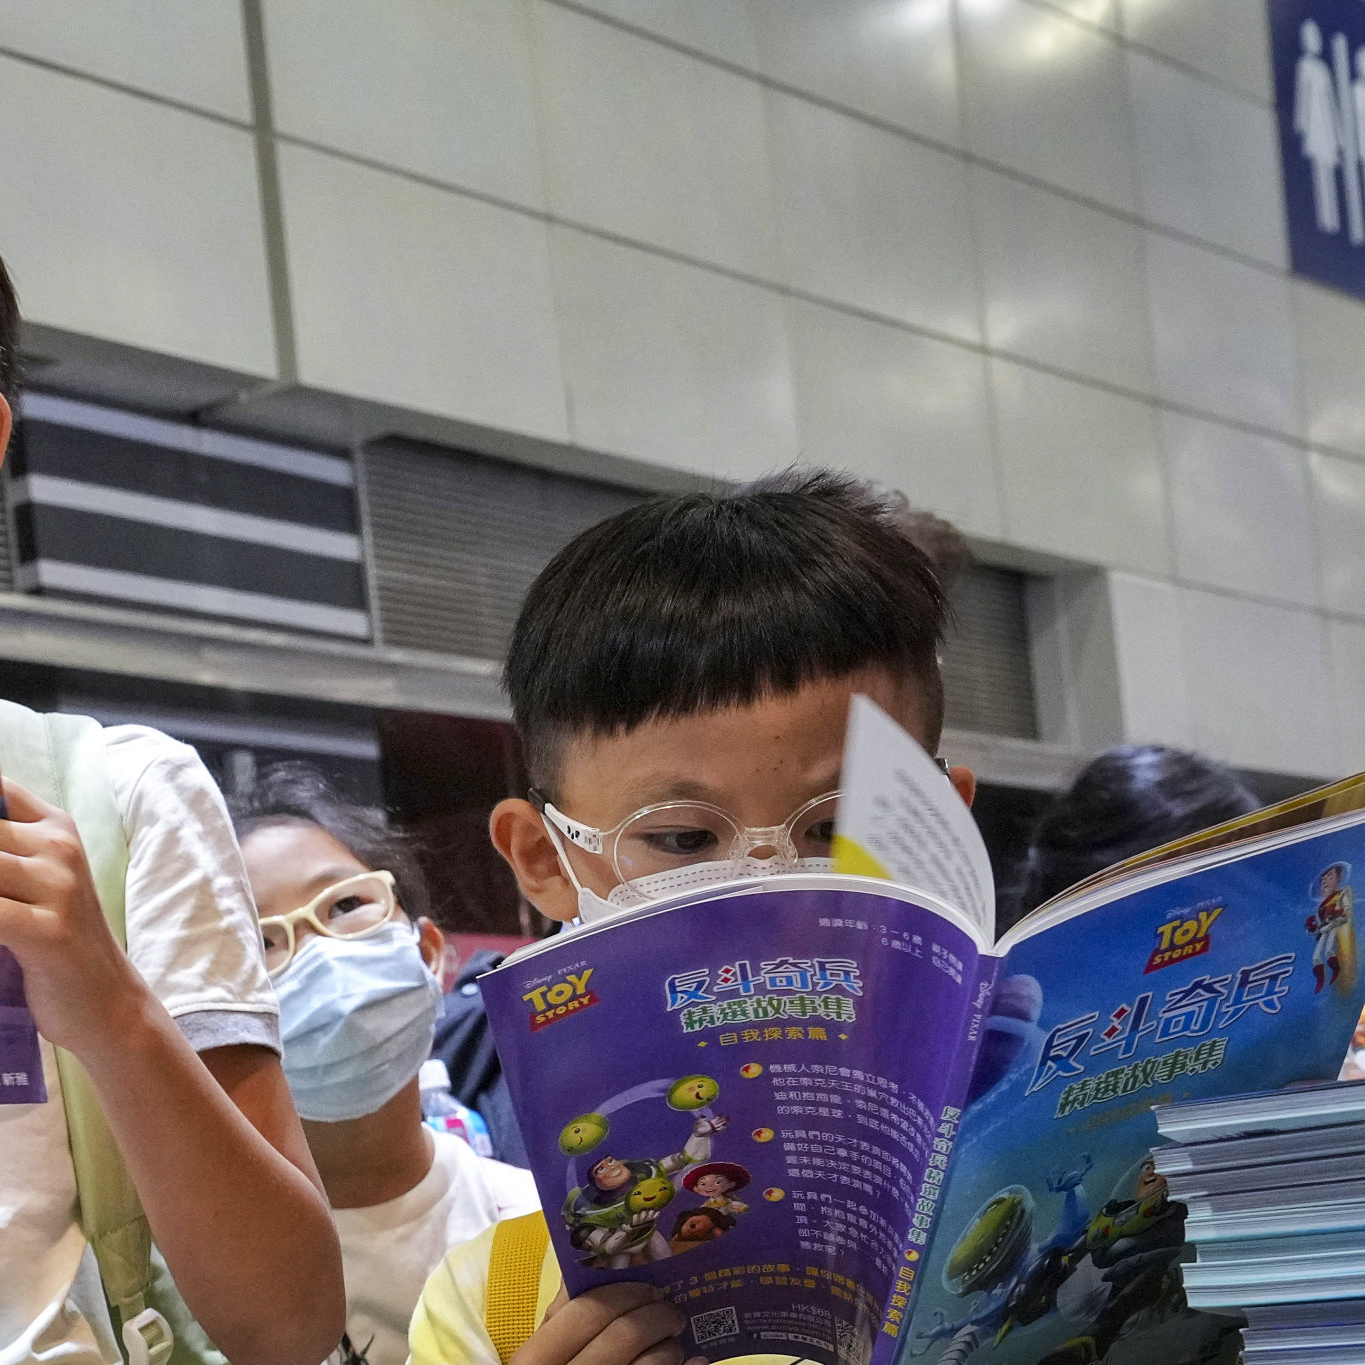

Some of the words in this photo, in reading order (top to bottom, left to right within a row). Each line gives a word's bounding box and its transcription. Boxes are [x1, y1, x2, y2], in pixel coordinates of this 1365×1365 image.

[1156, 907, 1224, 951] TOY
[557, 961, 588, 975] PIXAR
[1152, 940, 1209, 966] STORY
[522, 968, 594, 1013] TOY
[666, 957, 864, 1012] 反斗奇兵
[535, 995, 591, 1024] STORY
[680, 995, 857, 1033] 精選故事集
[966, 1014, 983, 1041] PIXAR
[1025, 953, 1296, 1097] 反斗奇兵
[720, 1026, 828, 1046] 自我探索篇
[1054, 1037, 1229, 1119] 精選故事集
[908, 1105, 963, 1246] 反斗奇兵精選故事集
[881, 1265, 916, 1339] 自我探索篇
